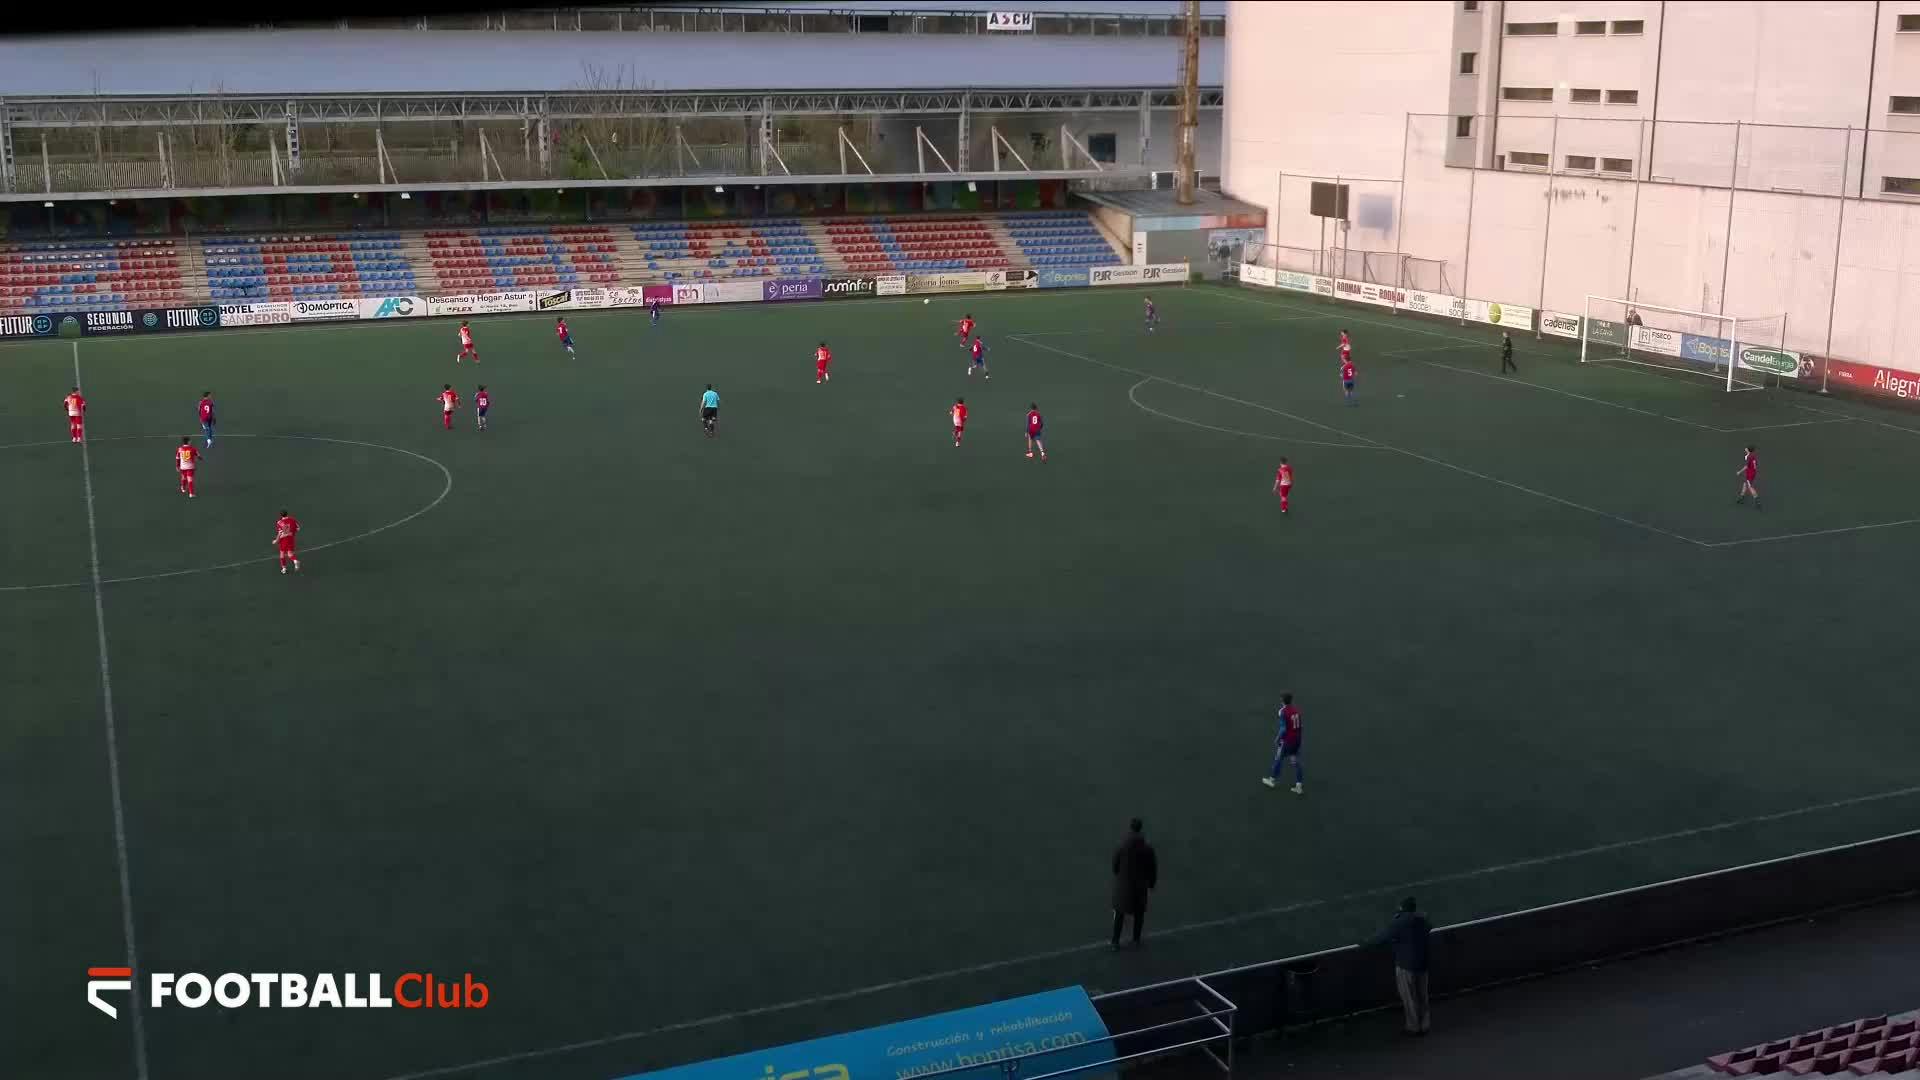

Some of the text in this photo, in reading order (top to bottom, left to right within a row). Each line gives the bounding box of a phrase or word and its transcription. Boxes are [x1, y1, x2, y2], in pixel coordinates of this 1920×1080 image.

[1093, 270, 1112, 281] PJR
[1143, 267, 1161, 279] PJR
[477, 294, 503, 303] Hogar
[504, 292, 527, 301] Astur
[220, 304, 255, 315] HOTEL
[87, 311, 133, 325] SEGUNDA
[88, 323, 134, 331] FEDERACIÓN
[204, 405, 210, 414] 9
